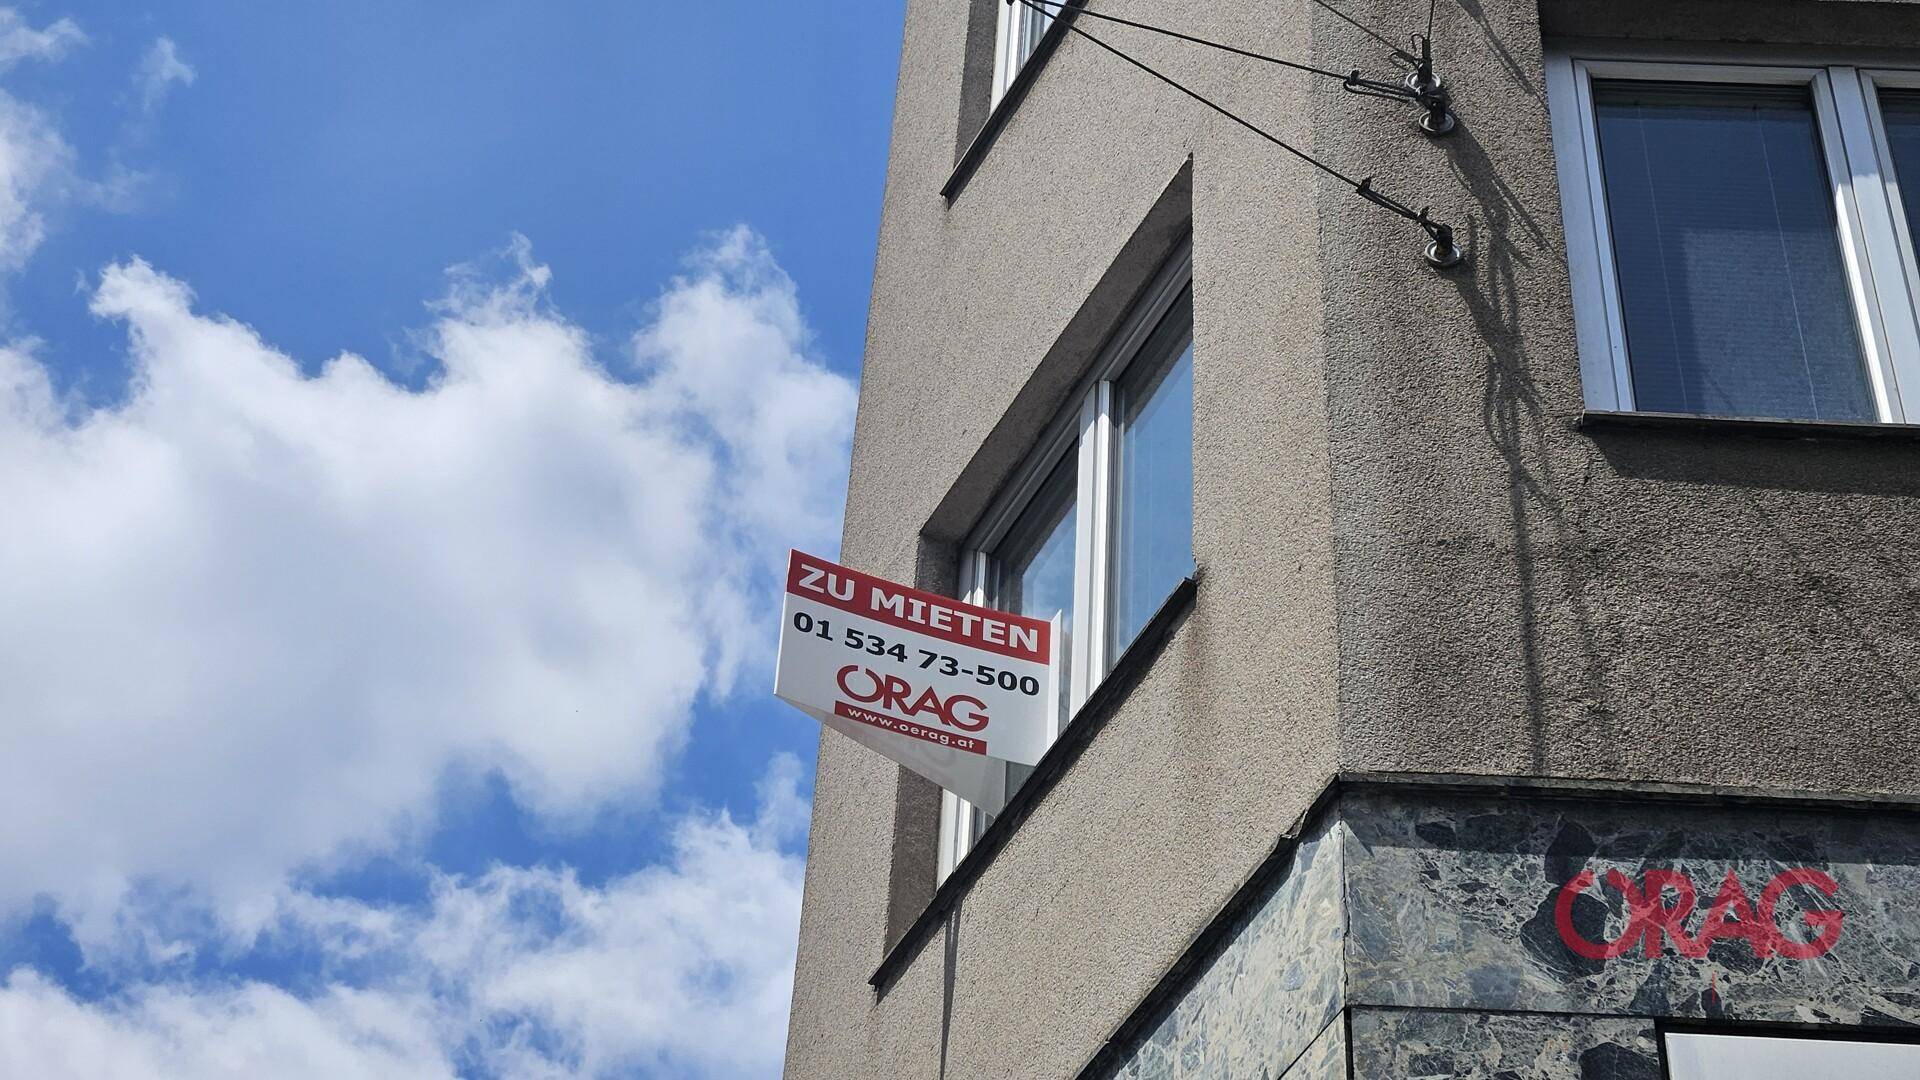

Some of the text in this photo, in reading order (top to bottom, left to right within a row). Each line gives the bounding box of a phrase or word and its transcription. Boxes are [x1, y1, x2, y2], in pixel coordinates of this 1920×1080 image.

[799, 564, 1038, 652] ZU MIETEN
[793, 612, 1039, 696] 01 534 73-500
[847, 708, 975, 749] www.oerag.at
